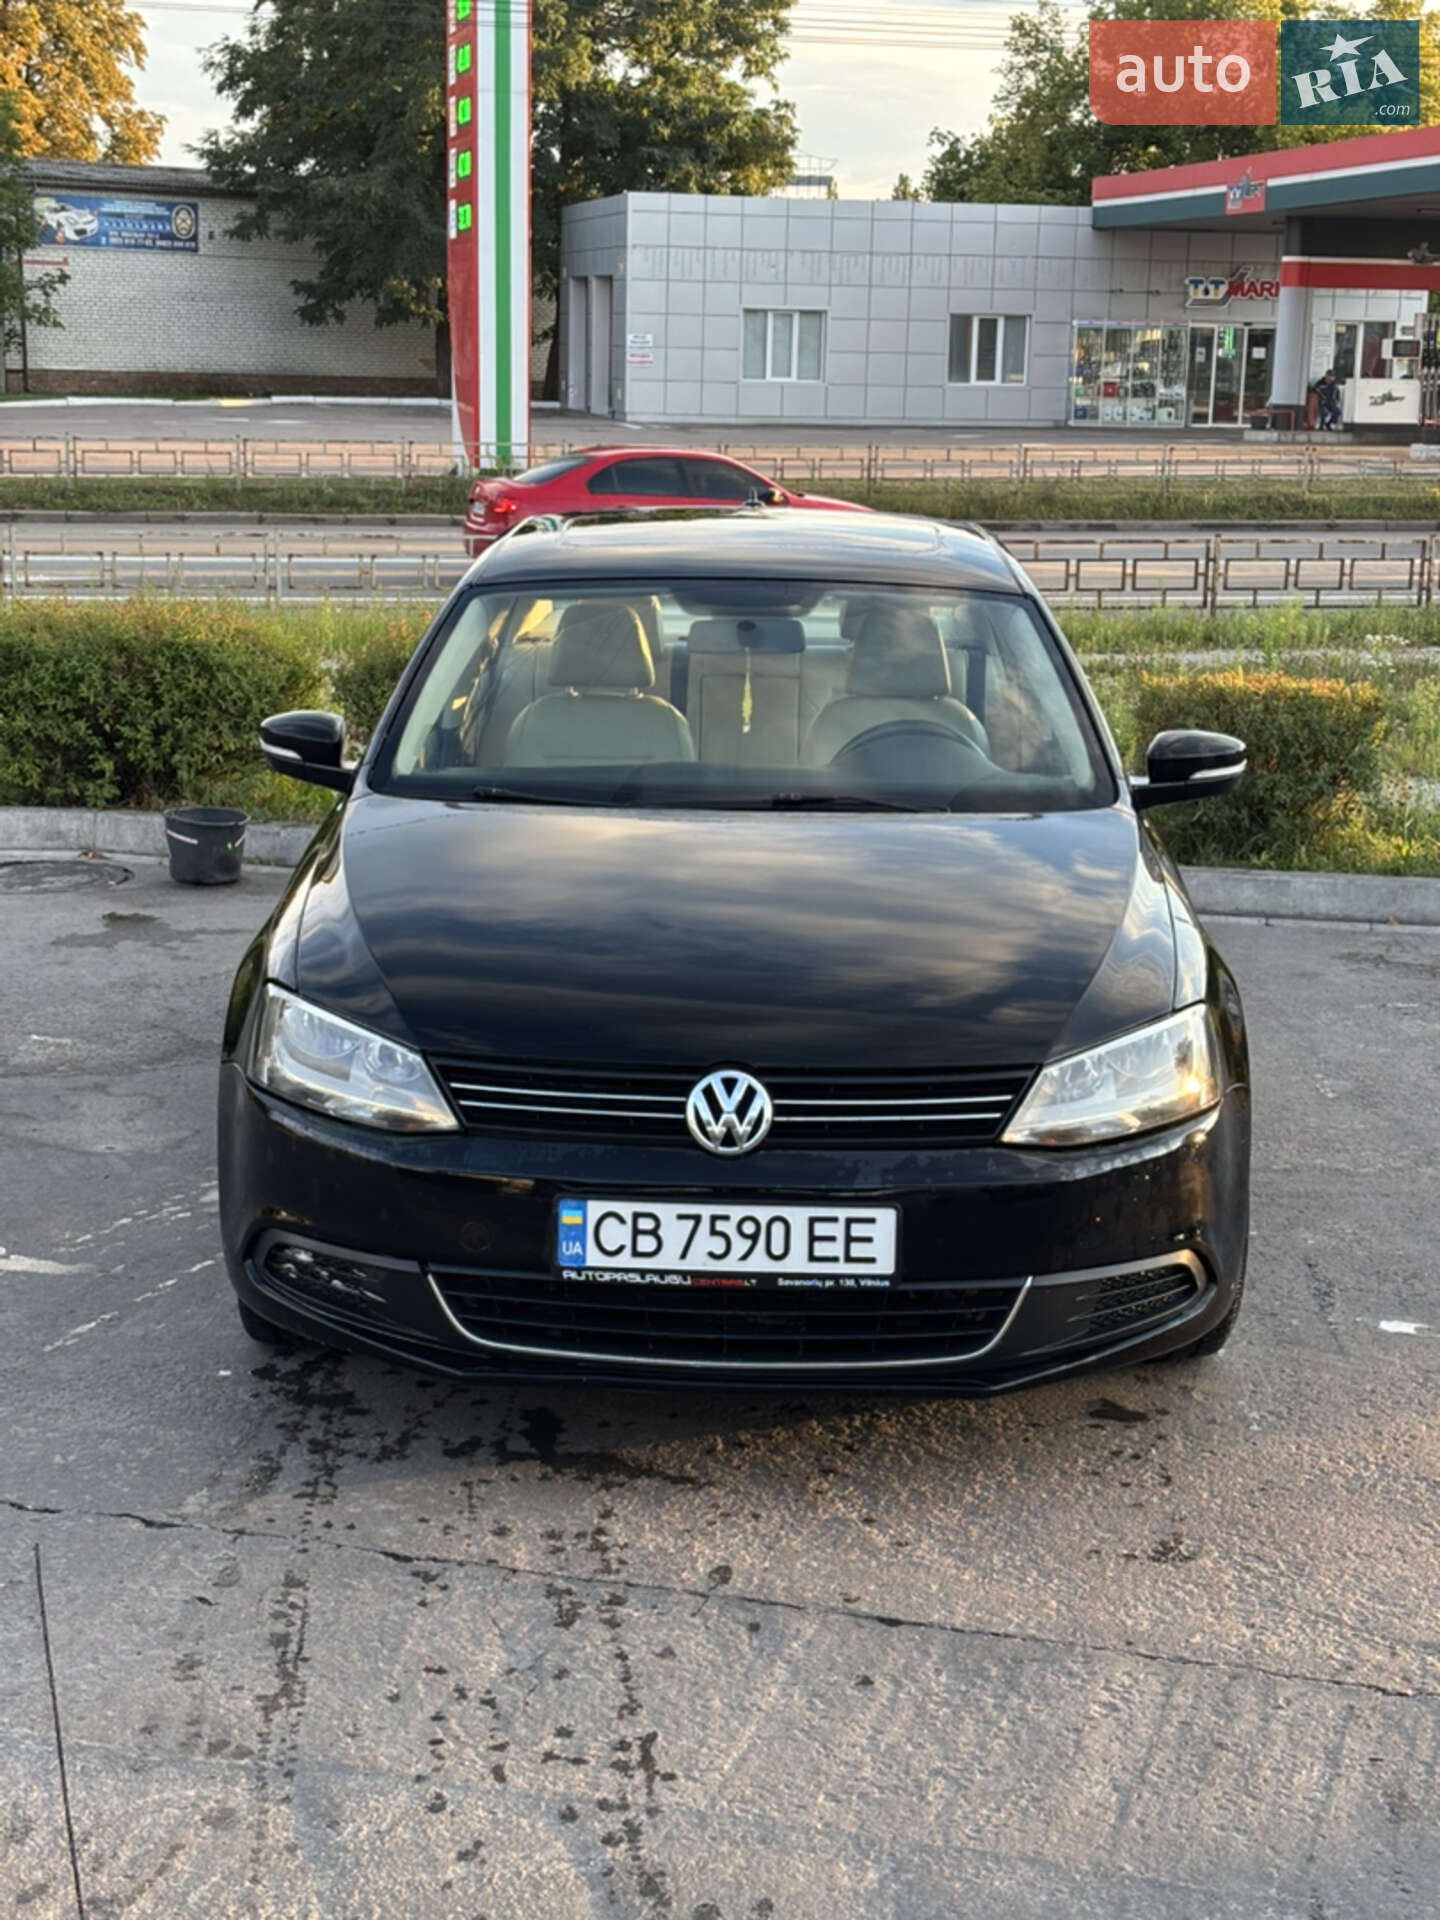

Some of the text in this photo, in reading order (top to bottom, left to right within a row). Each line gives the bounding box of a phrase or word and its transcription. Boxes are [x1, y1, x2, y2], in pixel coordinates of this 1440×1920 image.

[688, 1070, 772, 1155] VW
[562, 1241, 583, 1256] UA
[593, 1210, 877, 1264] CB 7590 EE
